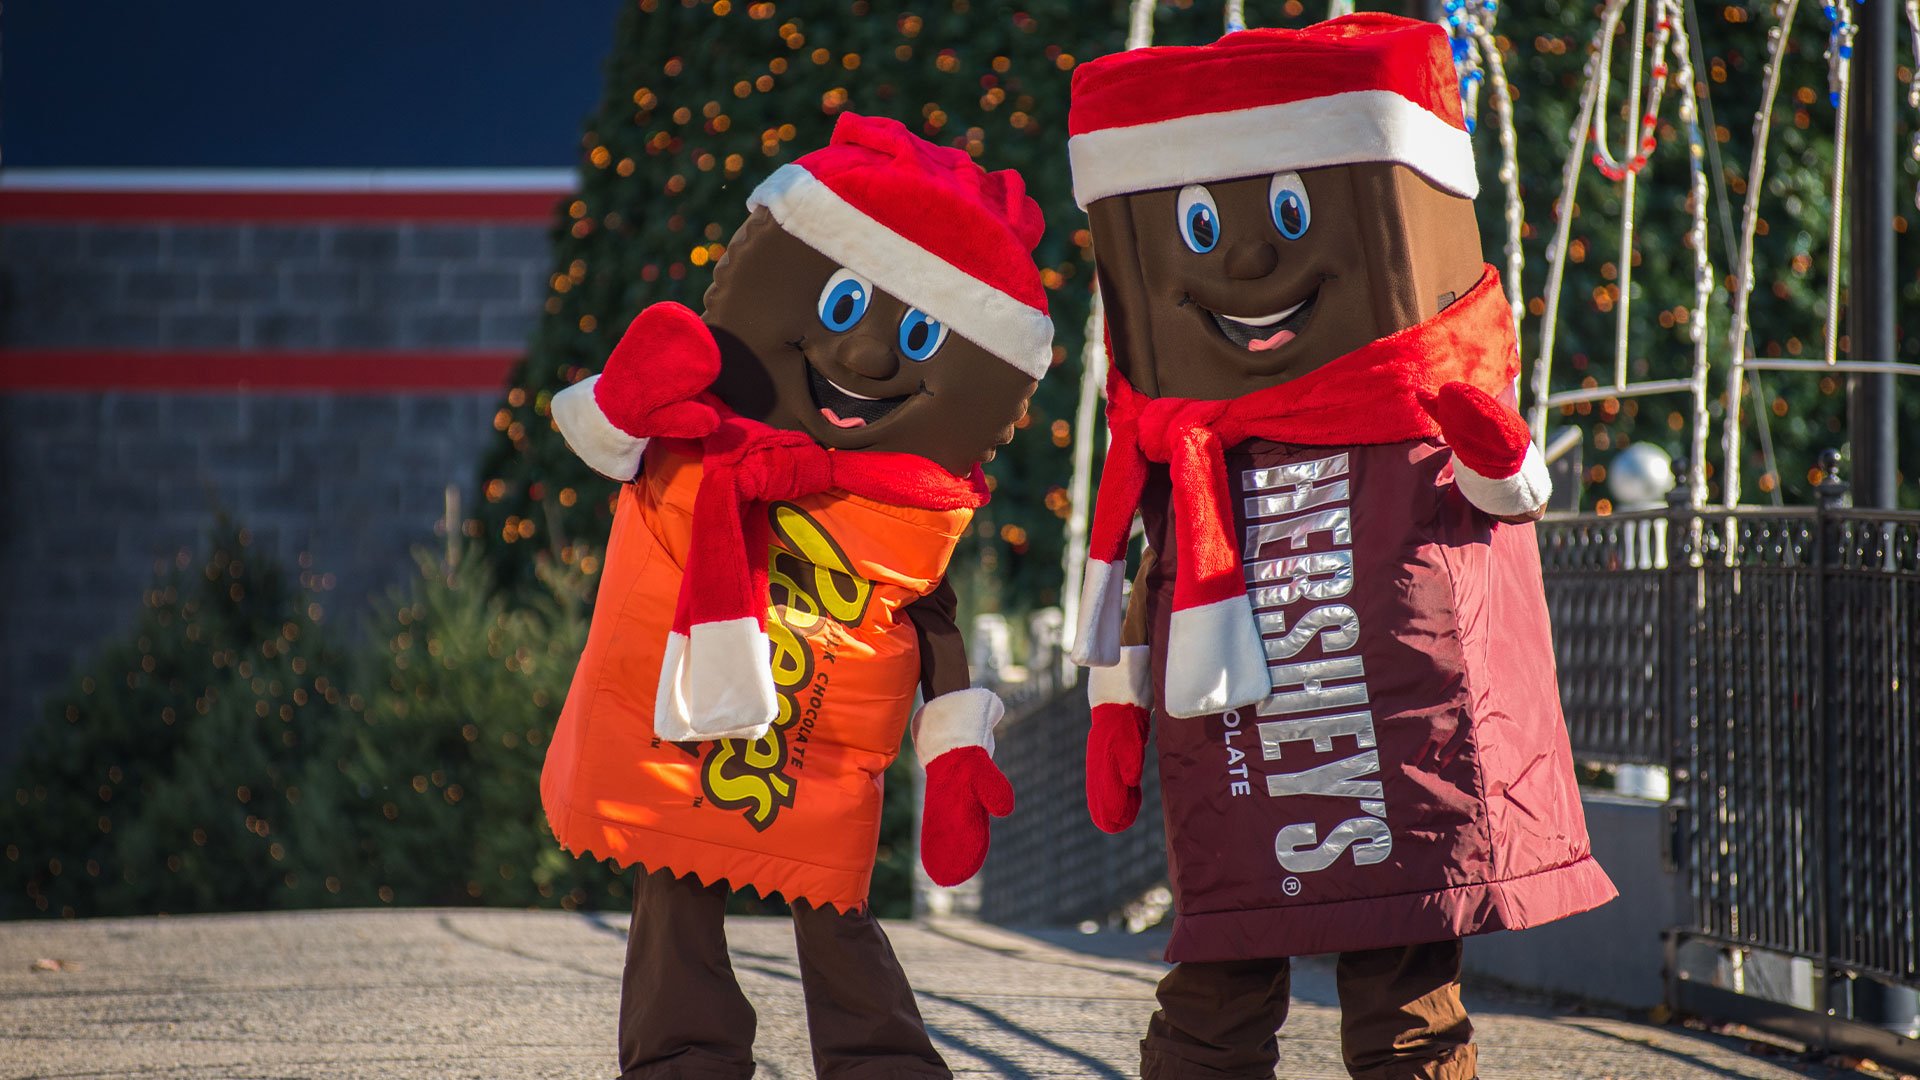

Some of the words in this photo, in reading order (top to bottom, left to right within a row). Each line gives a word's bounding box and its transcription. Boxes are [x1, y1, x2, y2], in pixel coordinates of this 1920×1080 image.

[1242, 452, 1392, 873] HERSHEY'S
[790, 671, 829, 770] CHOCOLATE
[1222, 708, 1250, 797] OLATE
